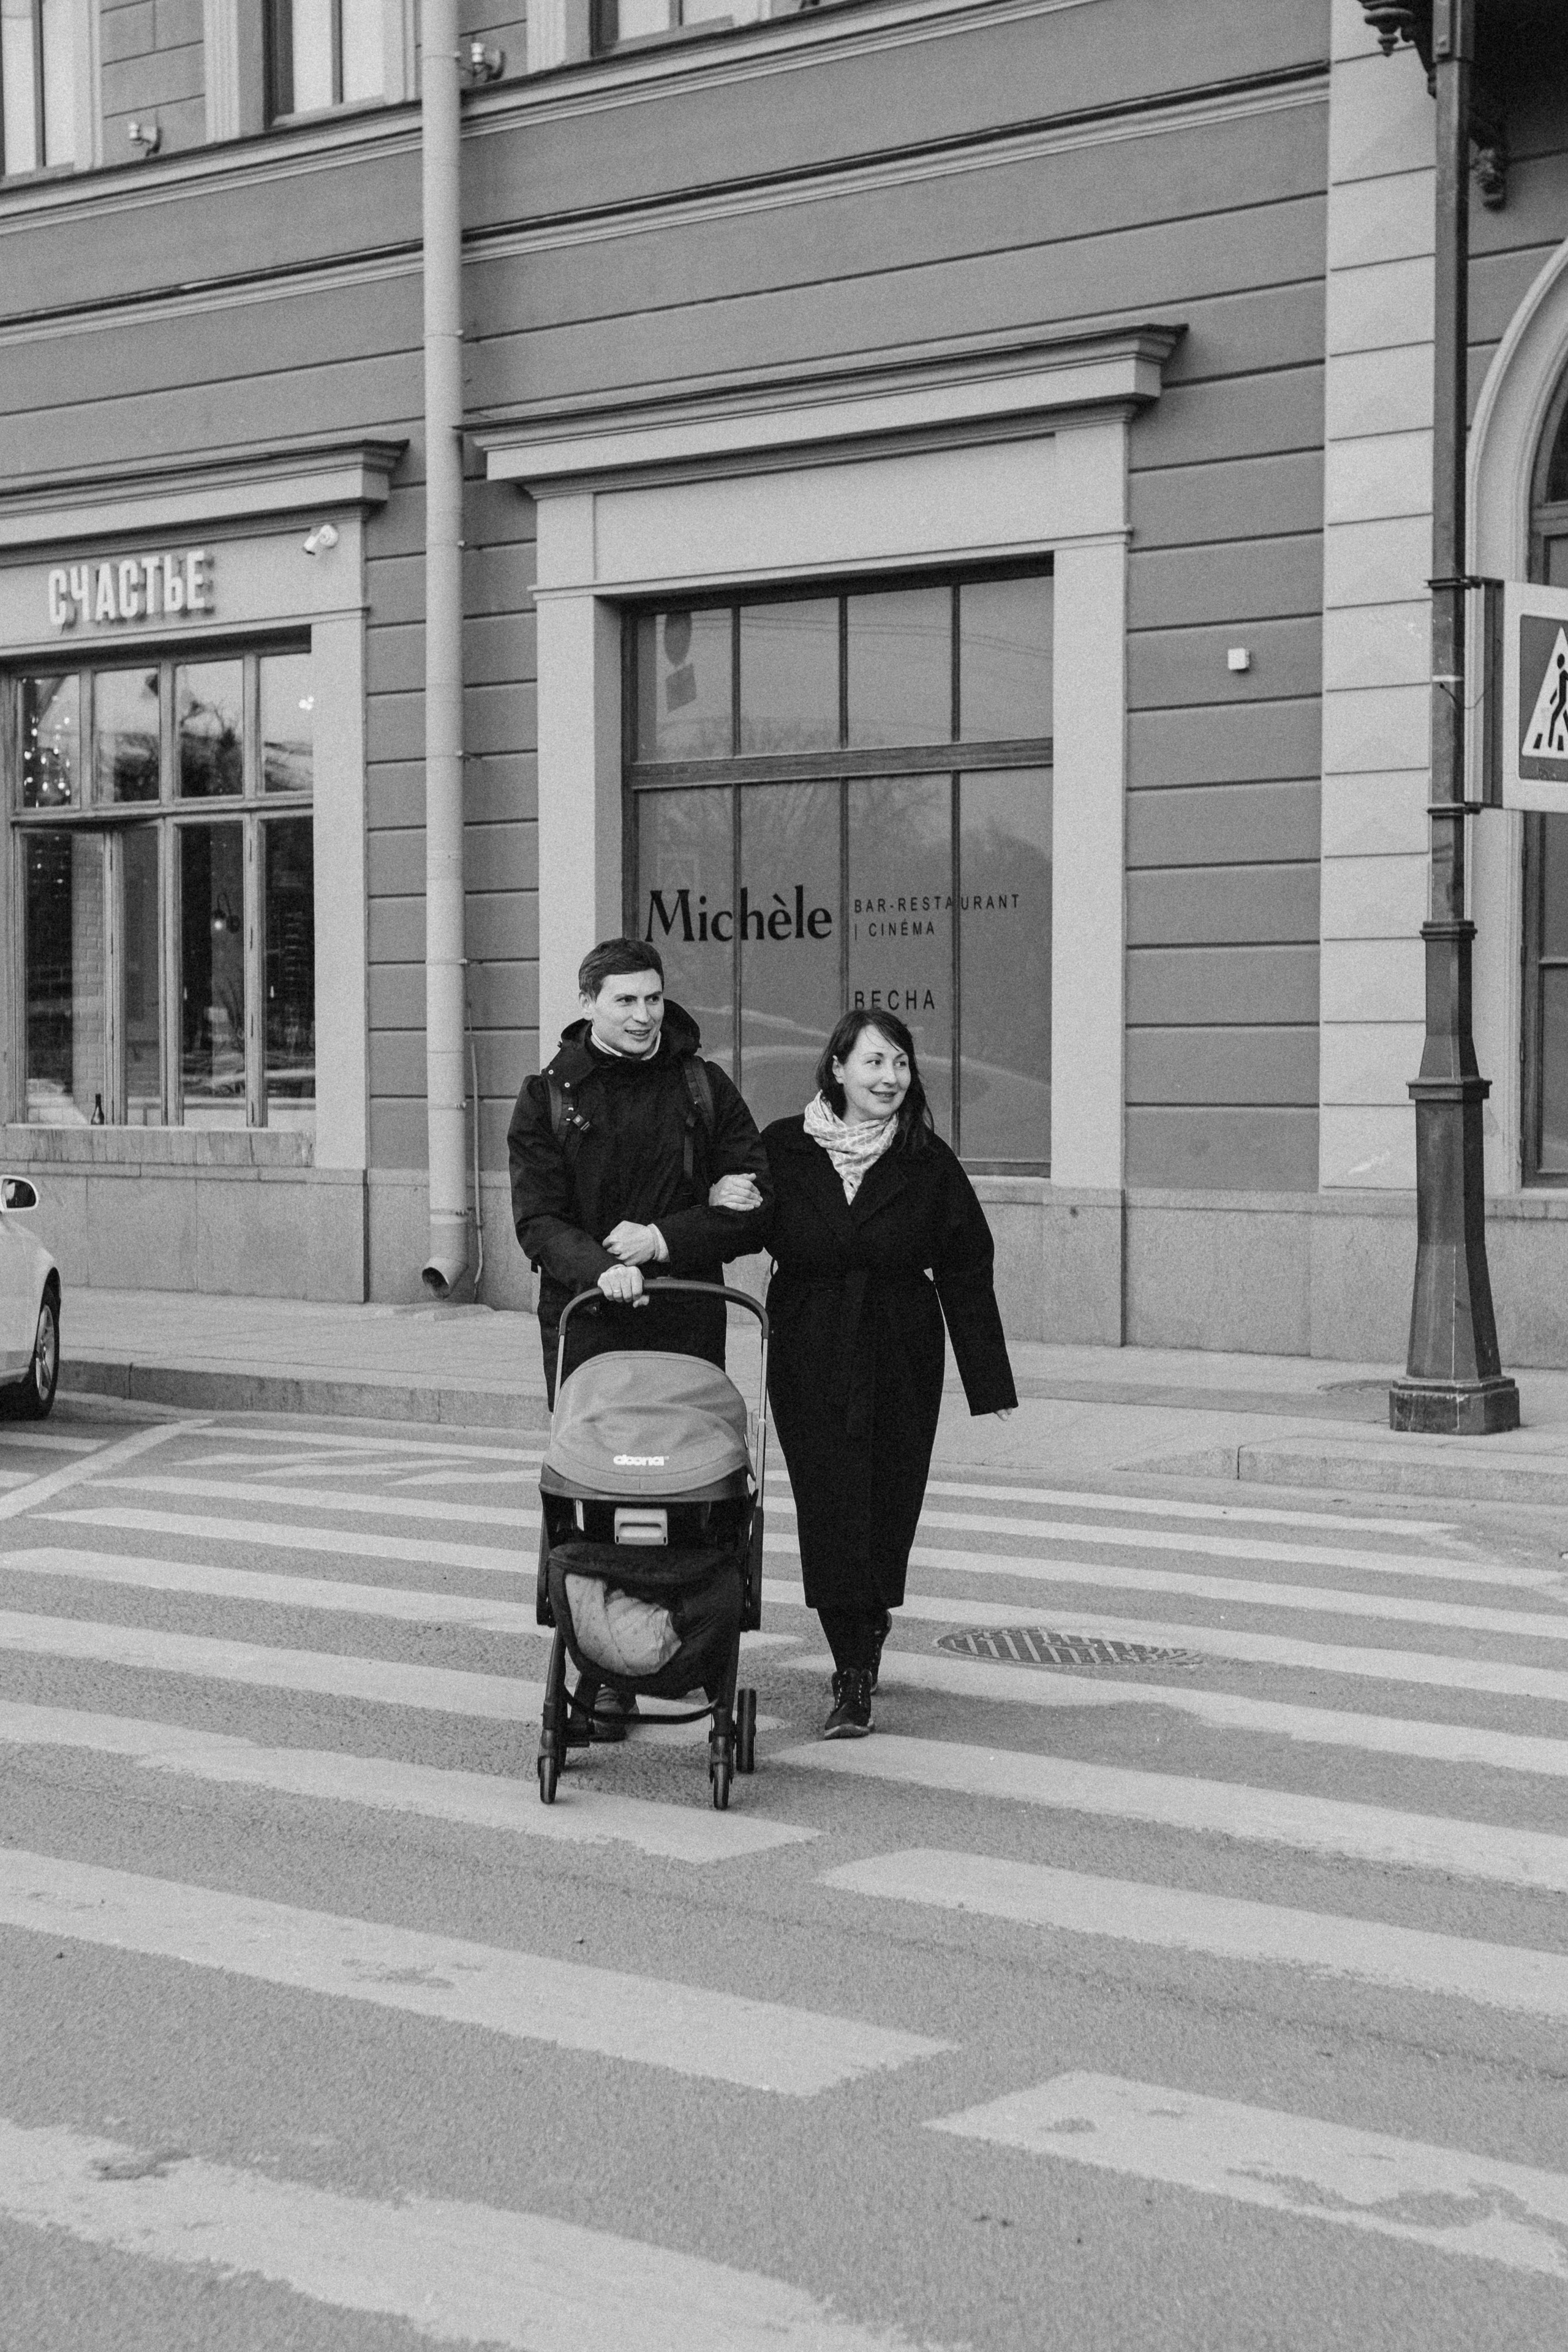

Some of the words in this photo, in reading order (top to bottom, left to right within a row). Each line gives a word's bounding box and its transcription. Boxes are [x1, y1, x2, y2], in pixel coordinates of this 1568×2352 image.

[48, 550, 205, 624] СЧАСТЬЕ
[854, 894, 1019, 913] BAR-RESTAURANT
[644, 884, 833, 943] Michèle
[869, 919, 935, 937] CINÉMA
[613, 1453, 665, 1466] doona
